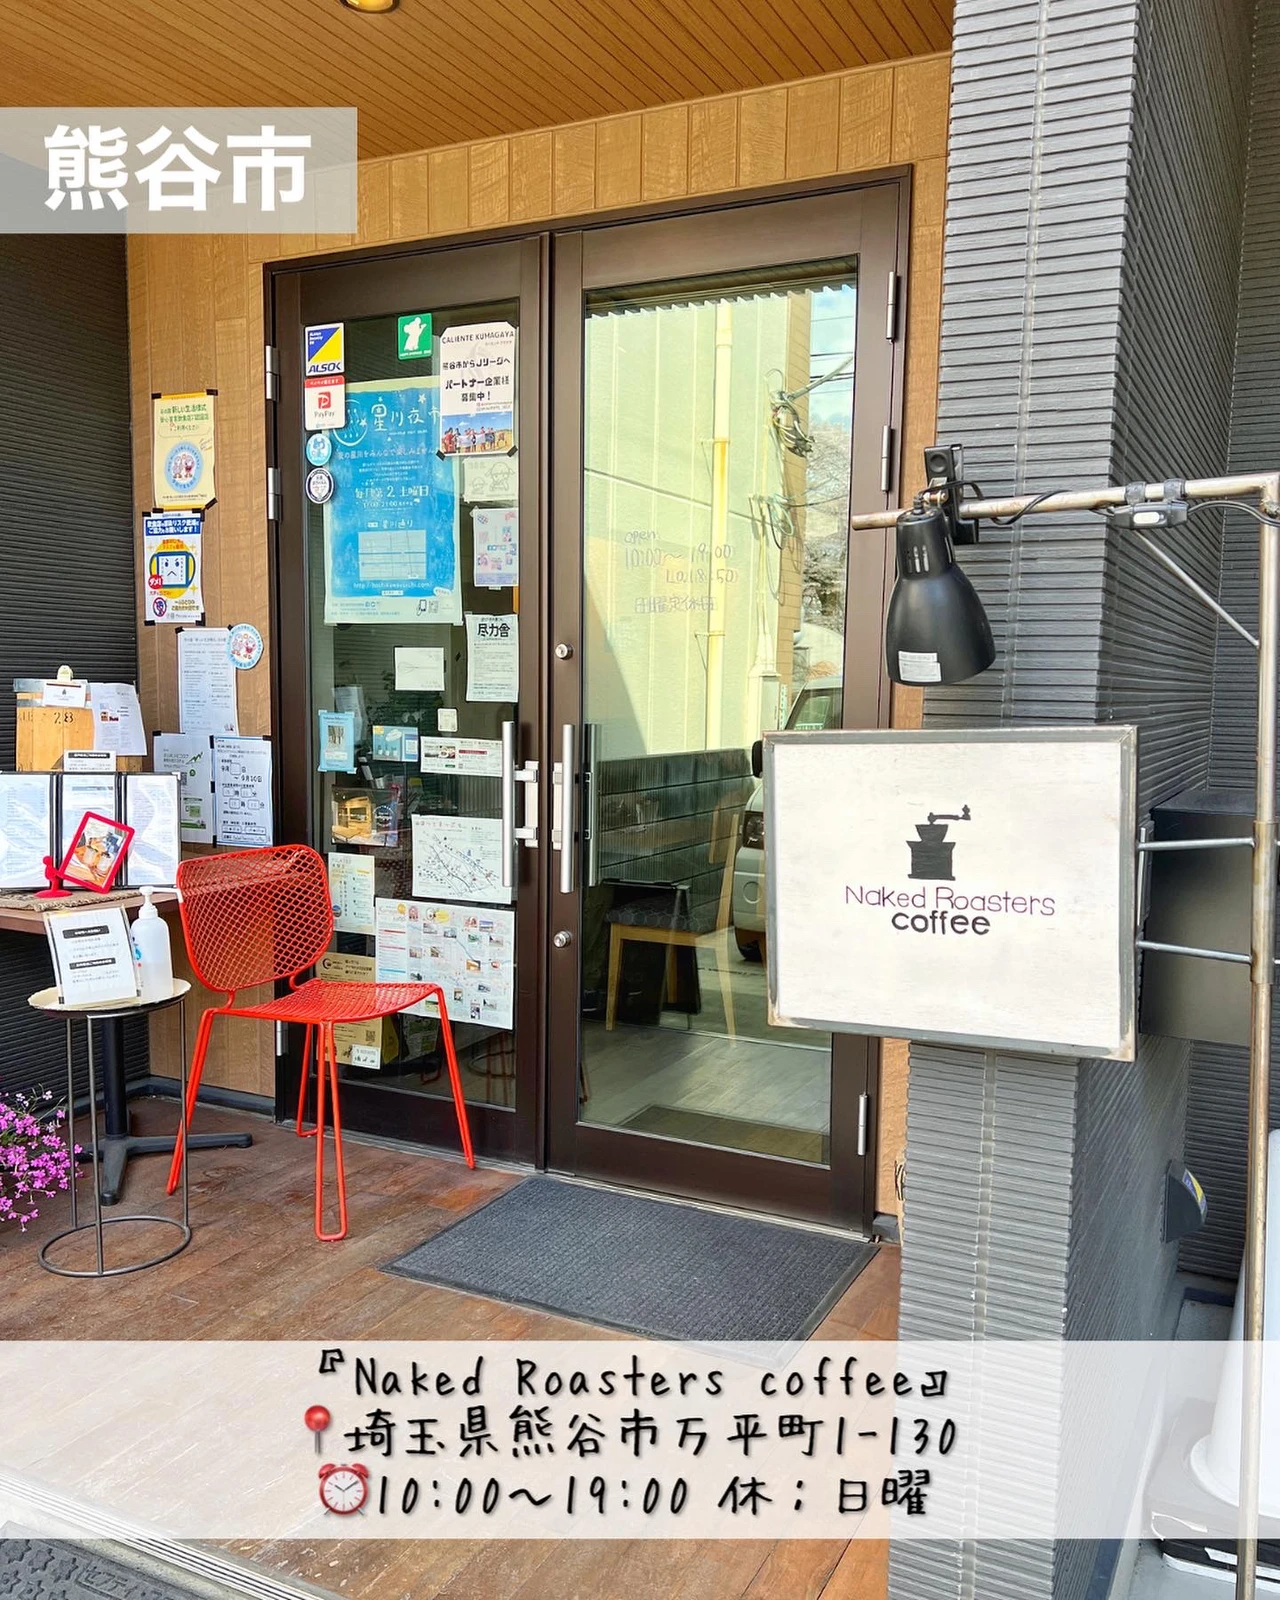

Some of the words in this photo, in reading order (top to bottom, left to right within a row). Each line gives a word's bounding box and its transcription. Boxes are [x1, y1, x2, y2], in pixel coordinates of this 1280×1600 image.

[442, 333, 473, 344] CALIENTE
[475, 330, 514, 341] KUMAGAYA
[307, 362, 341, 374] ALSOK
[845, 885, 926, 909] Naked
[935, 886, 1056, 916] Roasters
[891, 910, 991, 935] coffee
